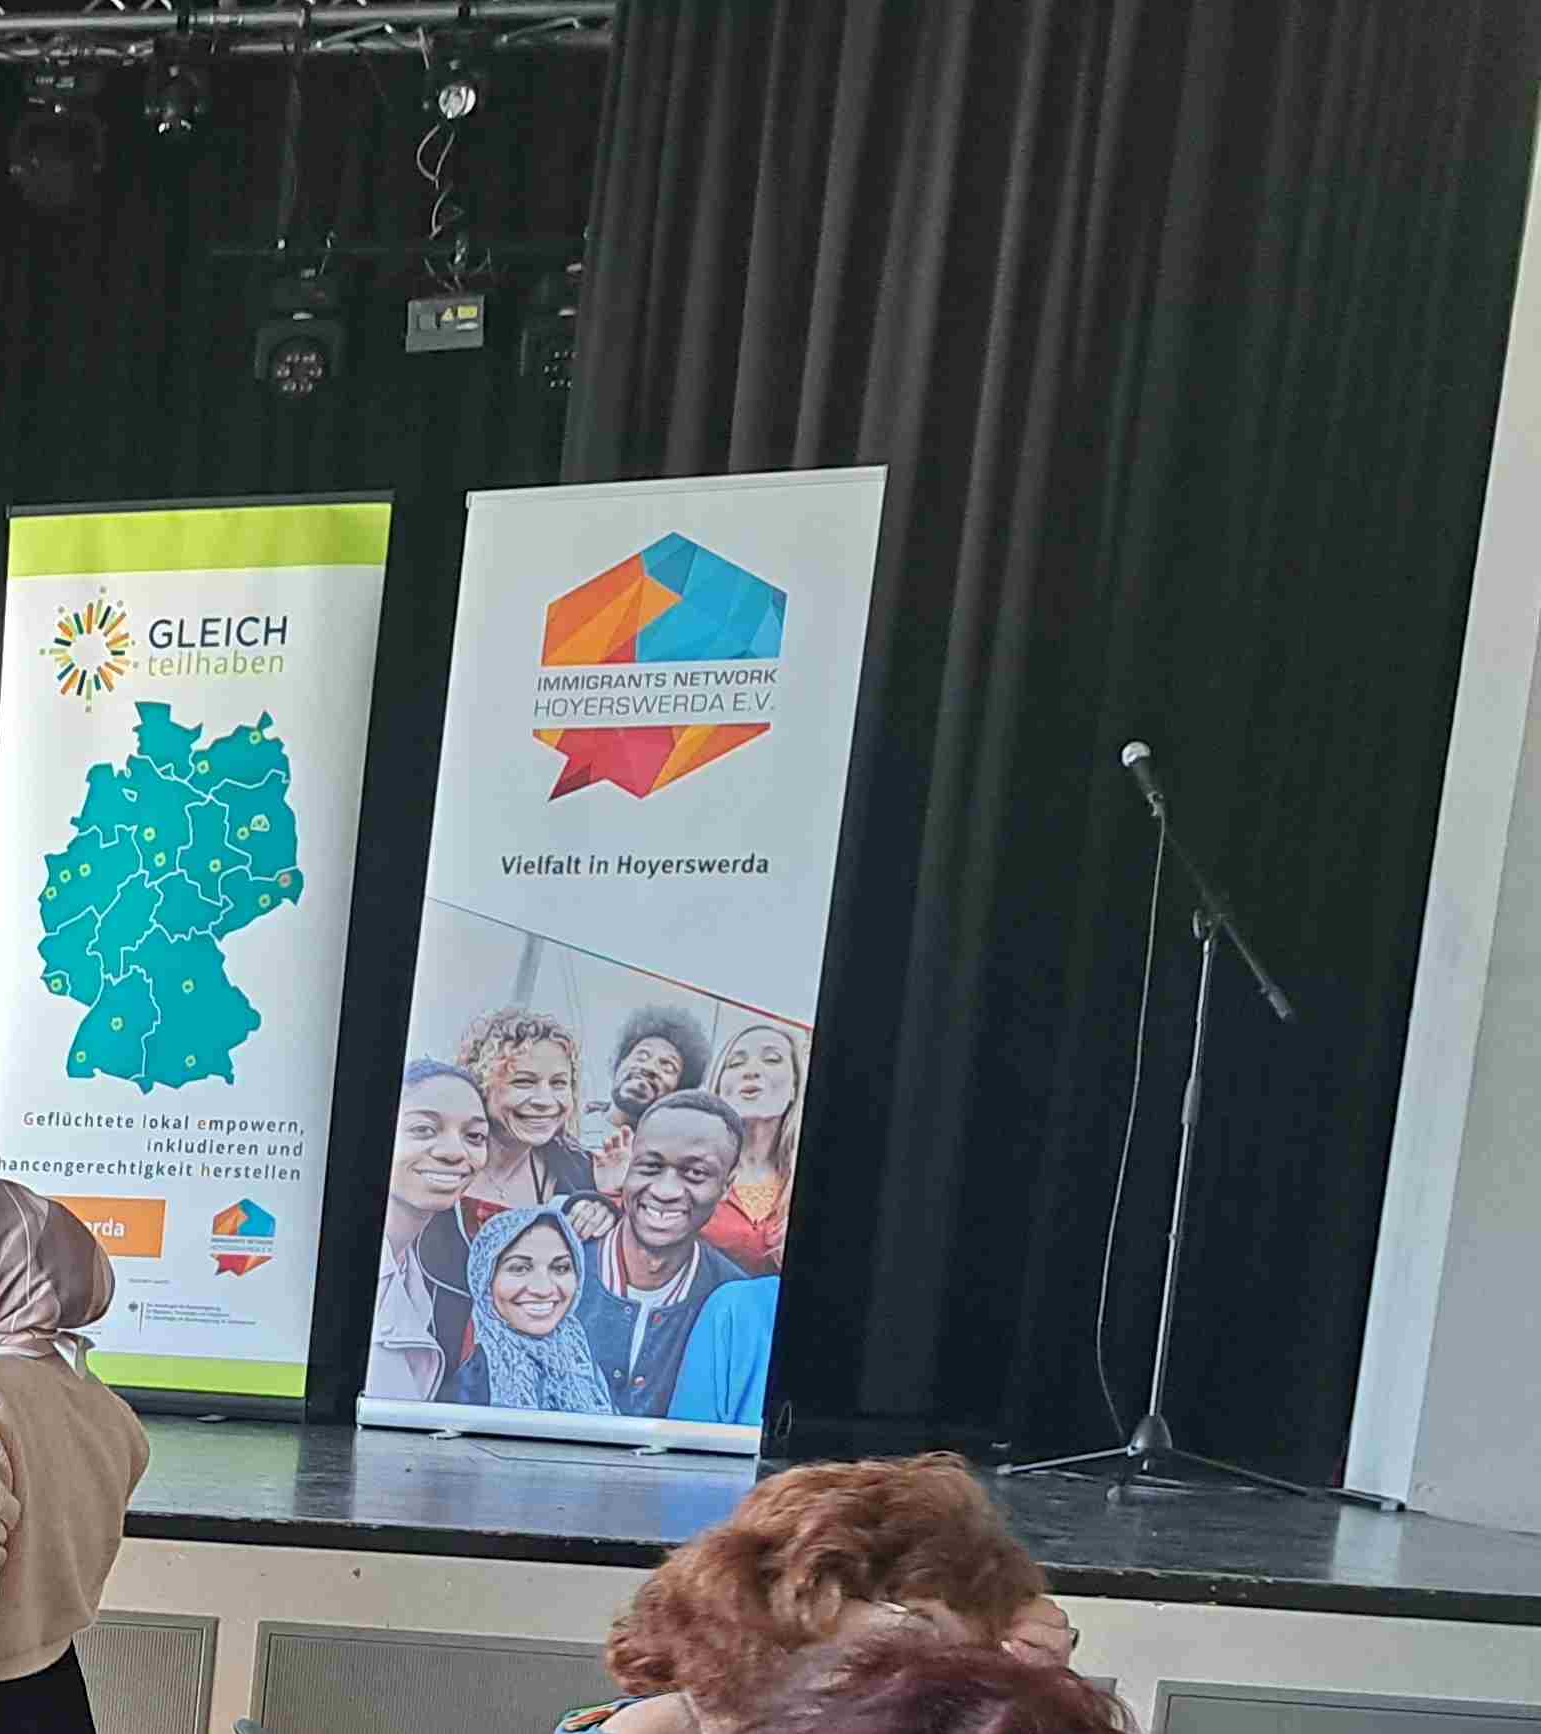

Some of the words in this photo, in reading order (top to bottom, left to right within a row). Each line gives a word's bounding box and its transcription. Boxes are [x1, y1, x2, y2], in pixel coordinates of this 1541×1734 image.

[148, 615, 289, 649] GLEICH
[147, 649, 285, 677] teilhaben
[536, 672, 667, 692] IMMIGRANTS
[672, 668, 778, 688] NETWORK
[533, 693, 725, 718] HOYERSWERDA
[732, 691, 776, 712] E.V.
[501, 855, 582, 876] Vielfalt
[588, 855, 609, 875] in
[616, 852, 769, 879] Hoyerswerda
[23, 1110, 134, 1130] Geflüchtete
[142, 1113, 189, 1131] lokal
[197, 1117, 305, 1136] empowern,
[146, 1138, 259, 1156] inkludieren
[267, 1142, 304, 1158] und
[201, 1164, 301, 1182] herstellen
